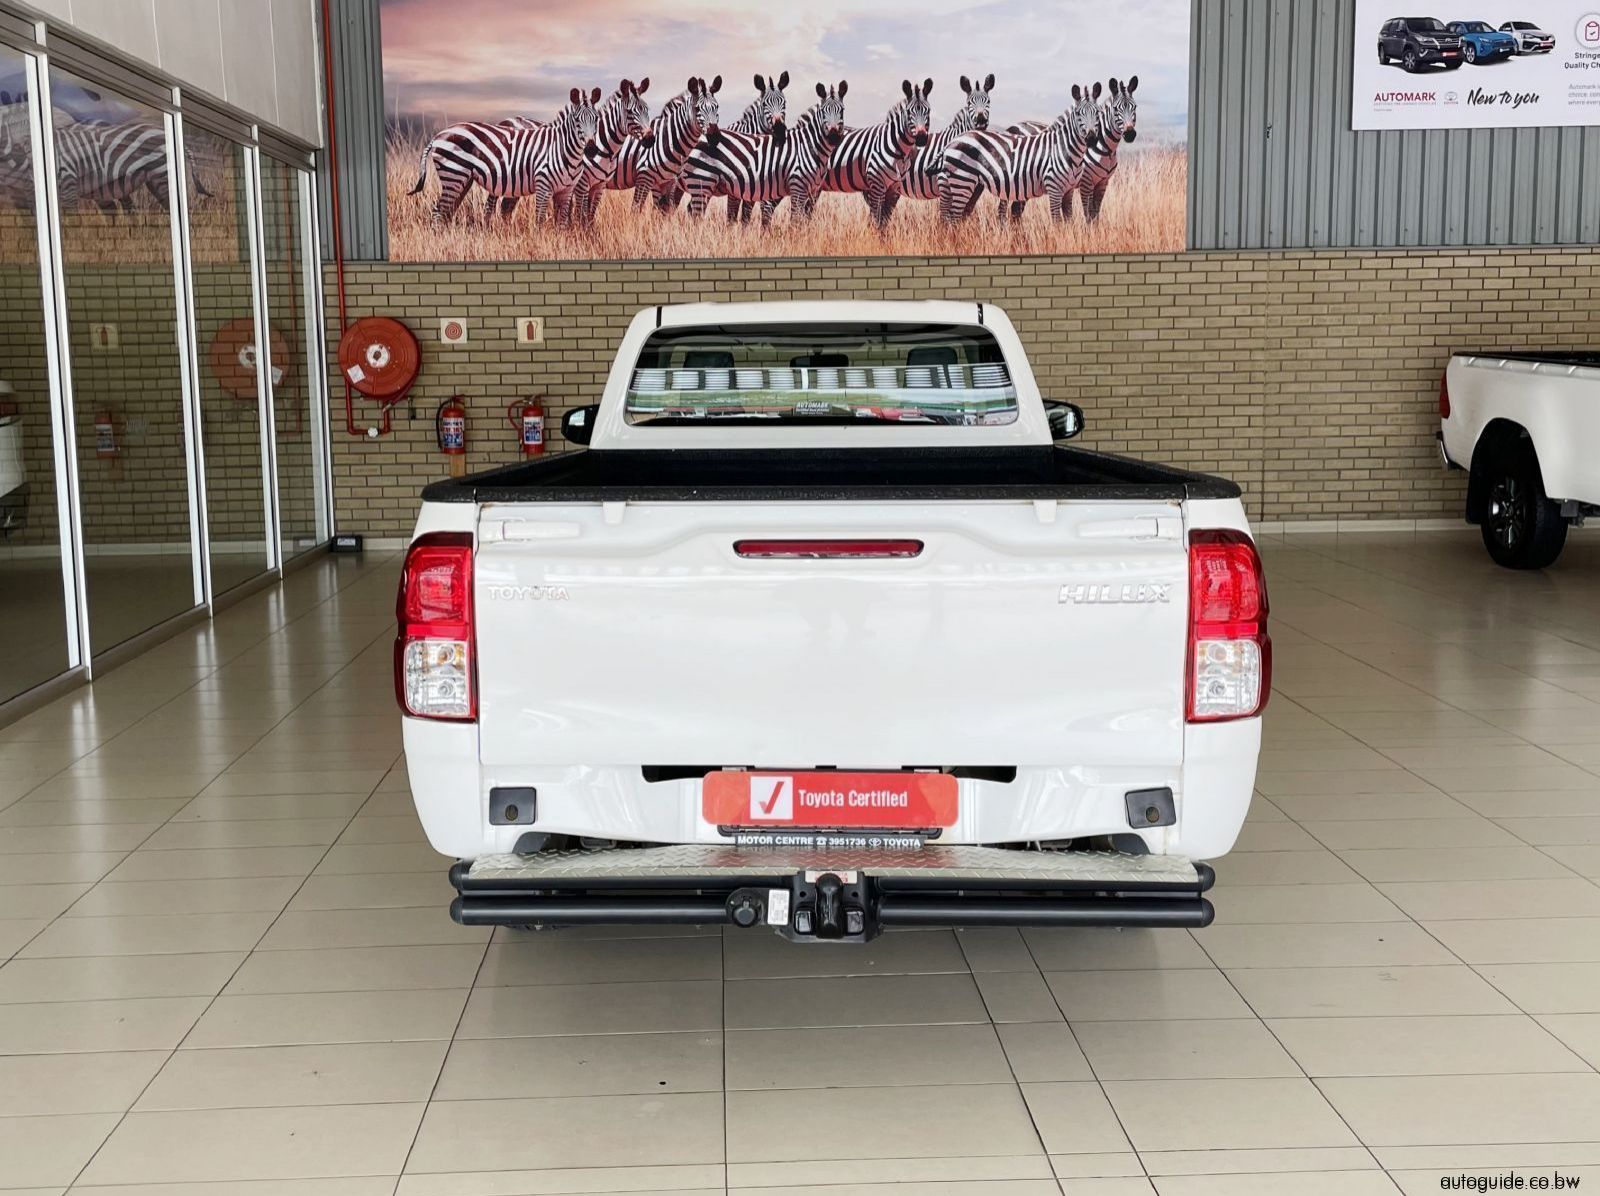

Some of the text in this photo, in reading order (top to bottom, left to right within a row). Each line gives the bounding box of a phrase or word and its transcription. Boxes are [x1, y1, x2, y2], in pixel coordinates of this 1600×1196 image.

[1564, 61, 1589, 70] Quality
[1374, 92, 1436, 102] AUTOMARK
[1467, 87, 1539, 110] New to you
[487, 585, 569, 601] TOYOTA
[1058, 584, 1172, 604] HILUX
[798, 790, 908, 808] Toyota Certified
[737, 836, 773, 845] MOTOR
[775, 836, 814, 845] CENTRE
[883, 838, 921, 847] TOYOTA
